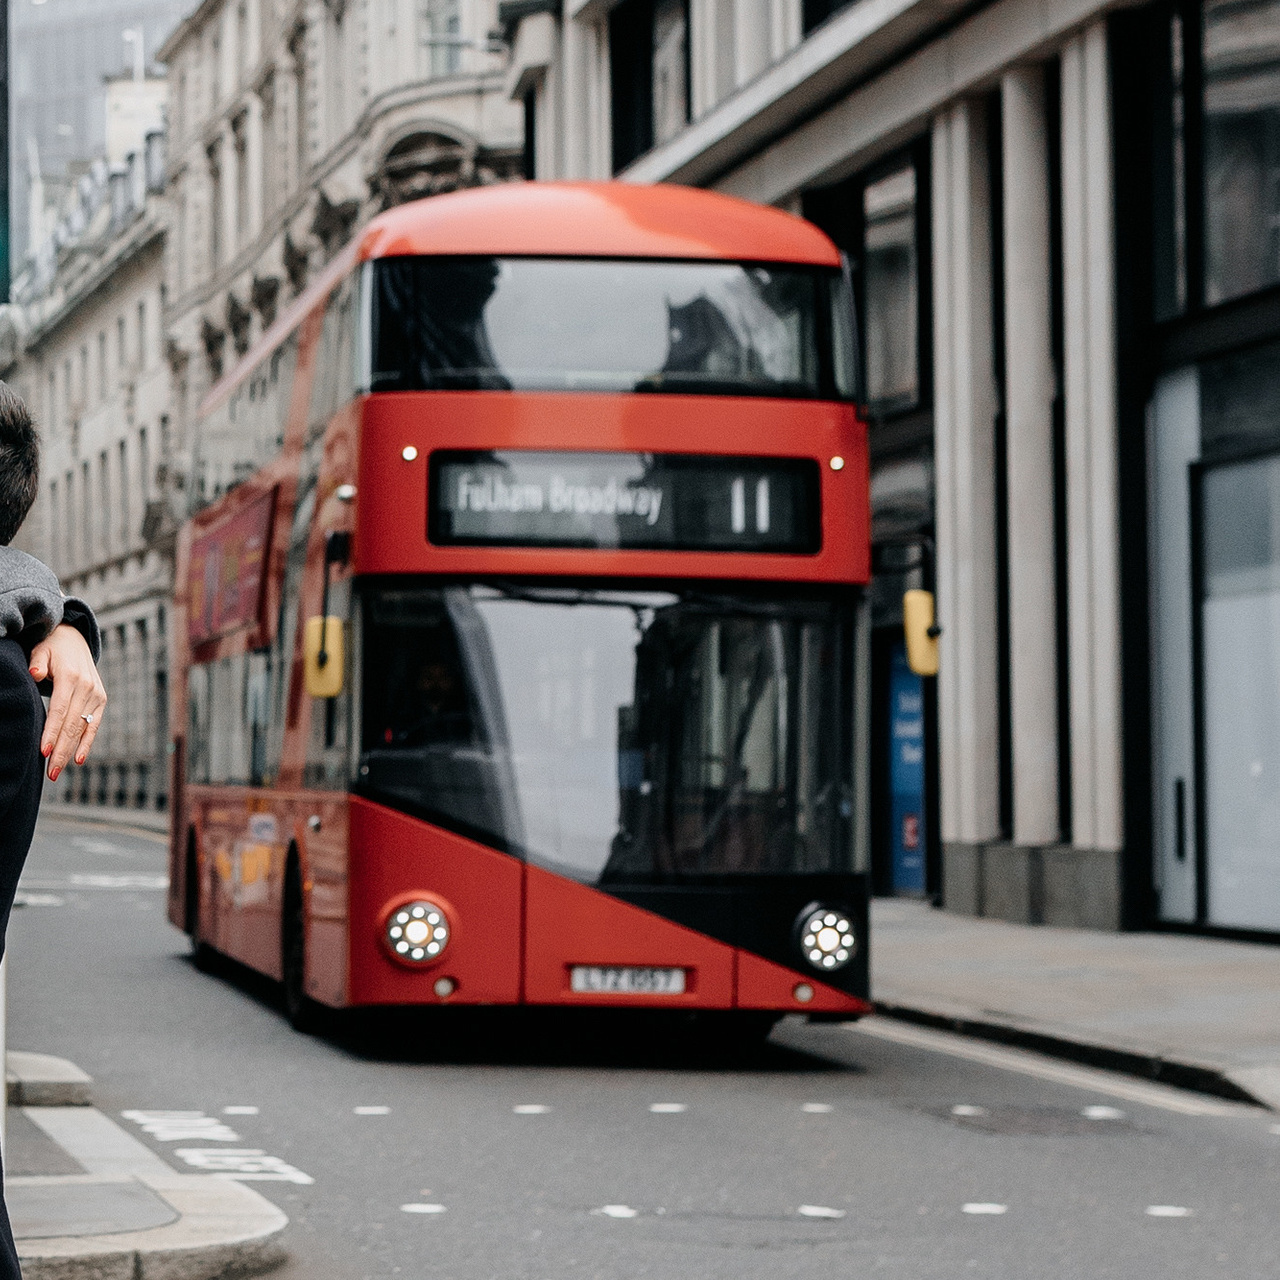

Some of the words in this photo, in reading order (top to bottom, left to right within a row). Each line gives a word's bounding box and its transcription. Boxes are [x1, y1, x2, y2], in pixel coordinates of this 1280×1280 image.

[458, 472, 544, 513] Fulham
[549, 473, 663, 526] Broadway
[730, 476, 771, 534] 11
